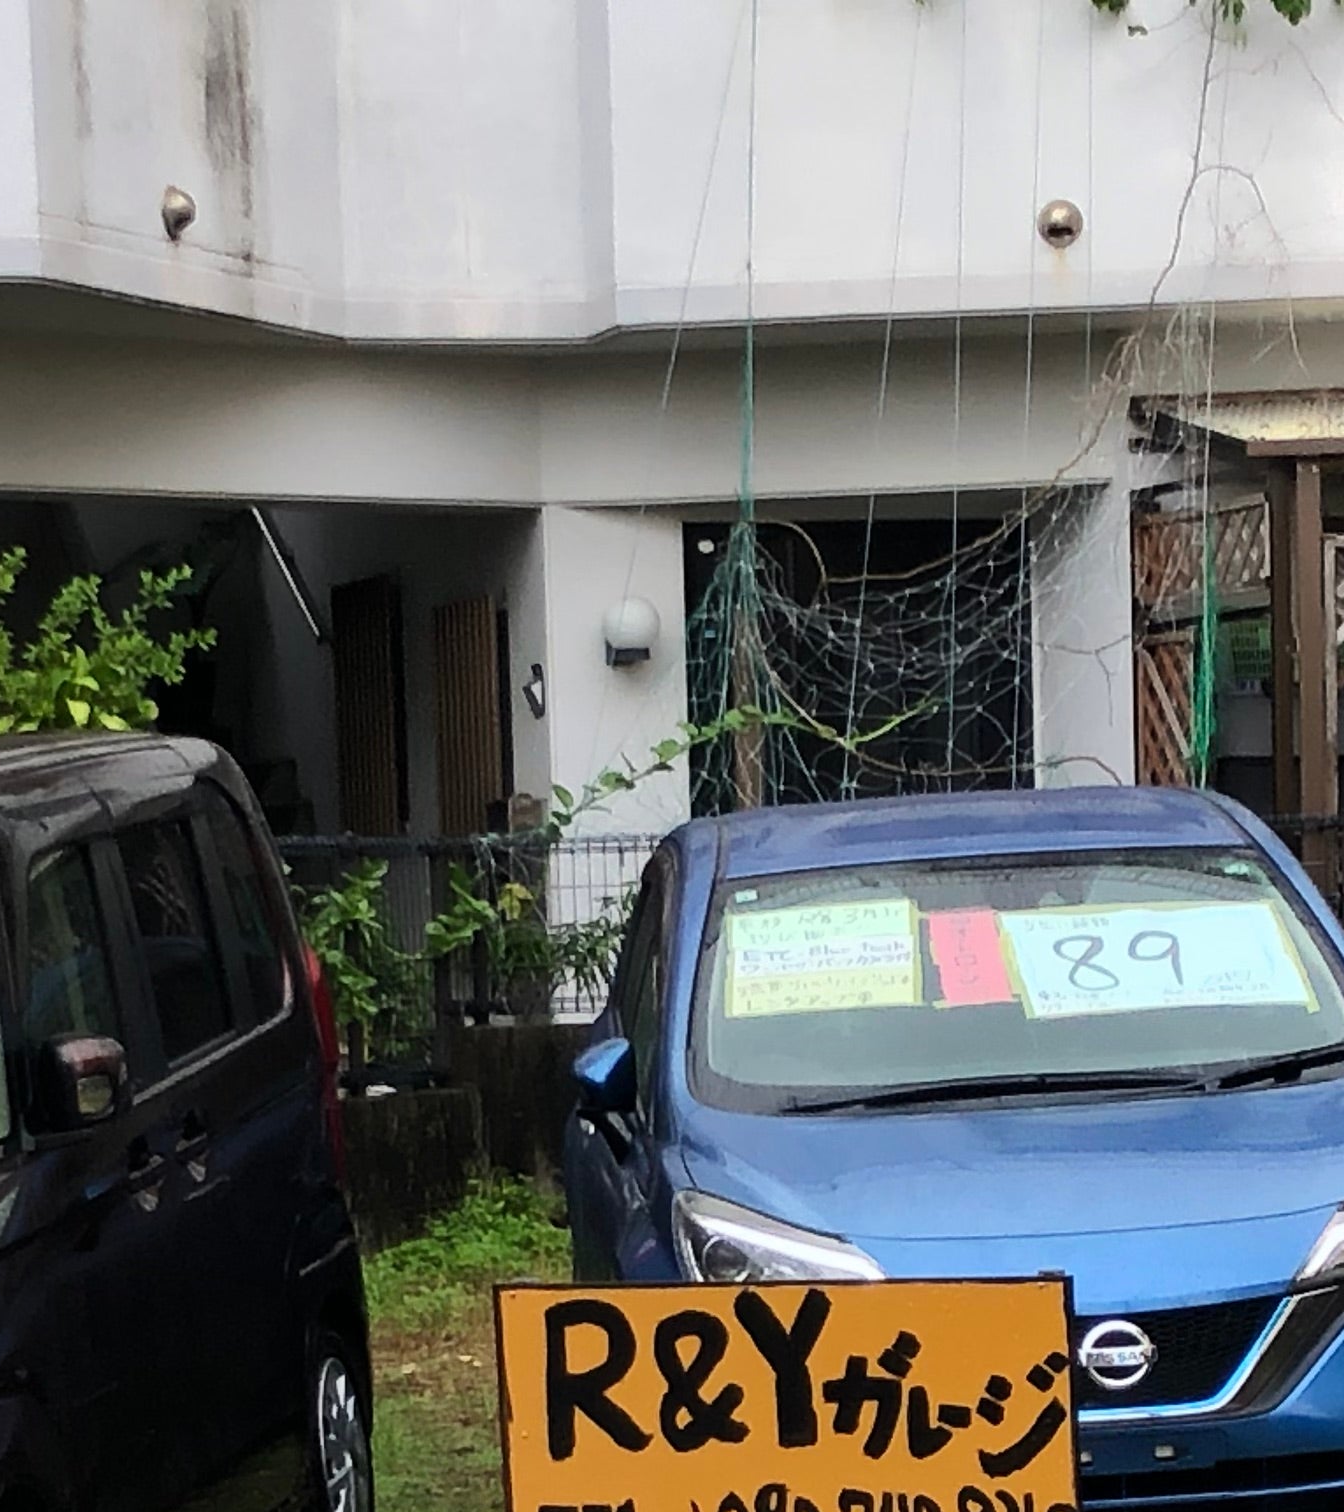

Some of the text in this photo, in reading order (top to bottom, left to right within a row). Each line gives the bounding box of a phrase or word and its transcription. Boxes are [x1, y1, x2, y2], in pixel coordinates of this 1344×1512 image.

[1052, 930, 1184, 991] 89
[545, 1288, 1069, 1478] R&Yガレージ
